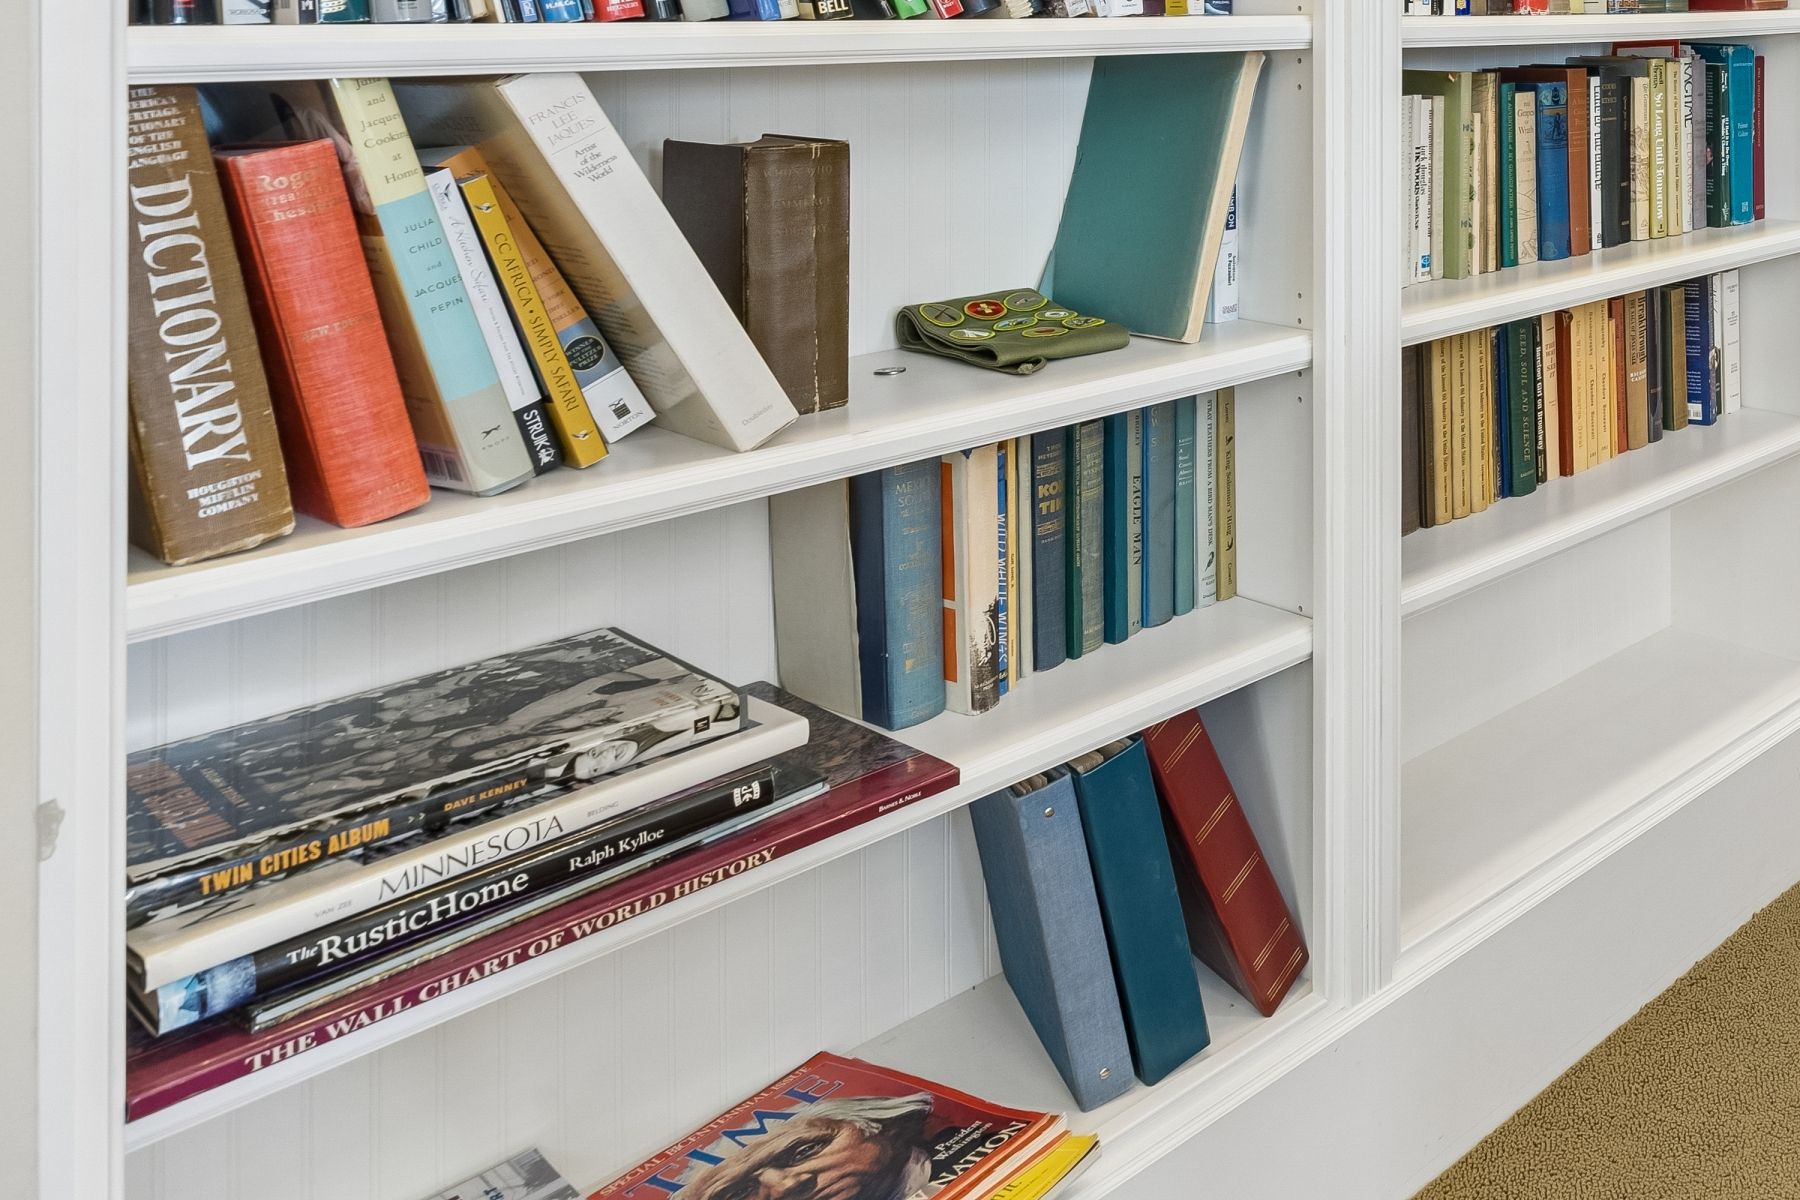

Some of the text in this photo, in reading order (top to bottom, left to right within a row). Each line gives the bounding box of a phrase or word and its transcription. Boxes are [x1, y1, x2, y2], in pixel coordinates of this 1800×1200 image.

[527, 93, 587, 127] FRANCIS
[551, 111, 579, 129] LEE
[546, 116, 597, 146] JAQUES
[383, 166, 421, 186] Home
[572, 154, 618, 181] Wilderness
[586, 166, 614, 184] World
[402, 216, 436, 235] JULIA
[408, 236, 443, 255] CHILD
[424, 260, 443, 273] and
[493, 231, 512, 255] CC
[504, 256, 534, 307] AFRICA
[414, 273, 464, 299] JACQUES
[429, 296, 465, 315] PEPIN
[129, 173, 252, 472] DICTIONARY
[527, 315, 580, 413] SIMPLY SAFARI
[522, 408, 552, 453] STRUIK
[611, 410, 644, 431] NORTON
[186, 469, 263, 501] HOUGHTON
[197, 492, 260, 519] COMPANY
[1132, 474, 1143, 567] EAGLE MAN
[443, 777, 529, 814] DAVE KENNEY
[200, 817, 391, 896] TWIN CITIES ALBUM
[378, 813, 565, 902] MINNESOTA
[568, 825, 666, 873] Ralph Kylloe
[243, 846, 778, 1073] THE WALL CHART OF WORLD HISTORY
[286, 944, 321, 965] The
[599, 1065, 811, 1197] SPECIAL BICENTENNIAL ISSUE
[623, 1073, 846, 1200] TIME
[932, 1121, 995, 1161] Washington
[933, 1119, 983, 1151] President
[927, 1120, 1030, 1189] NATION
